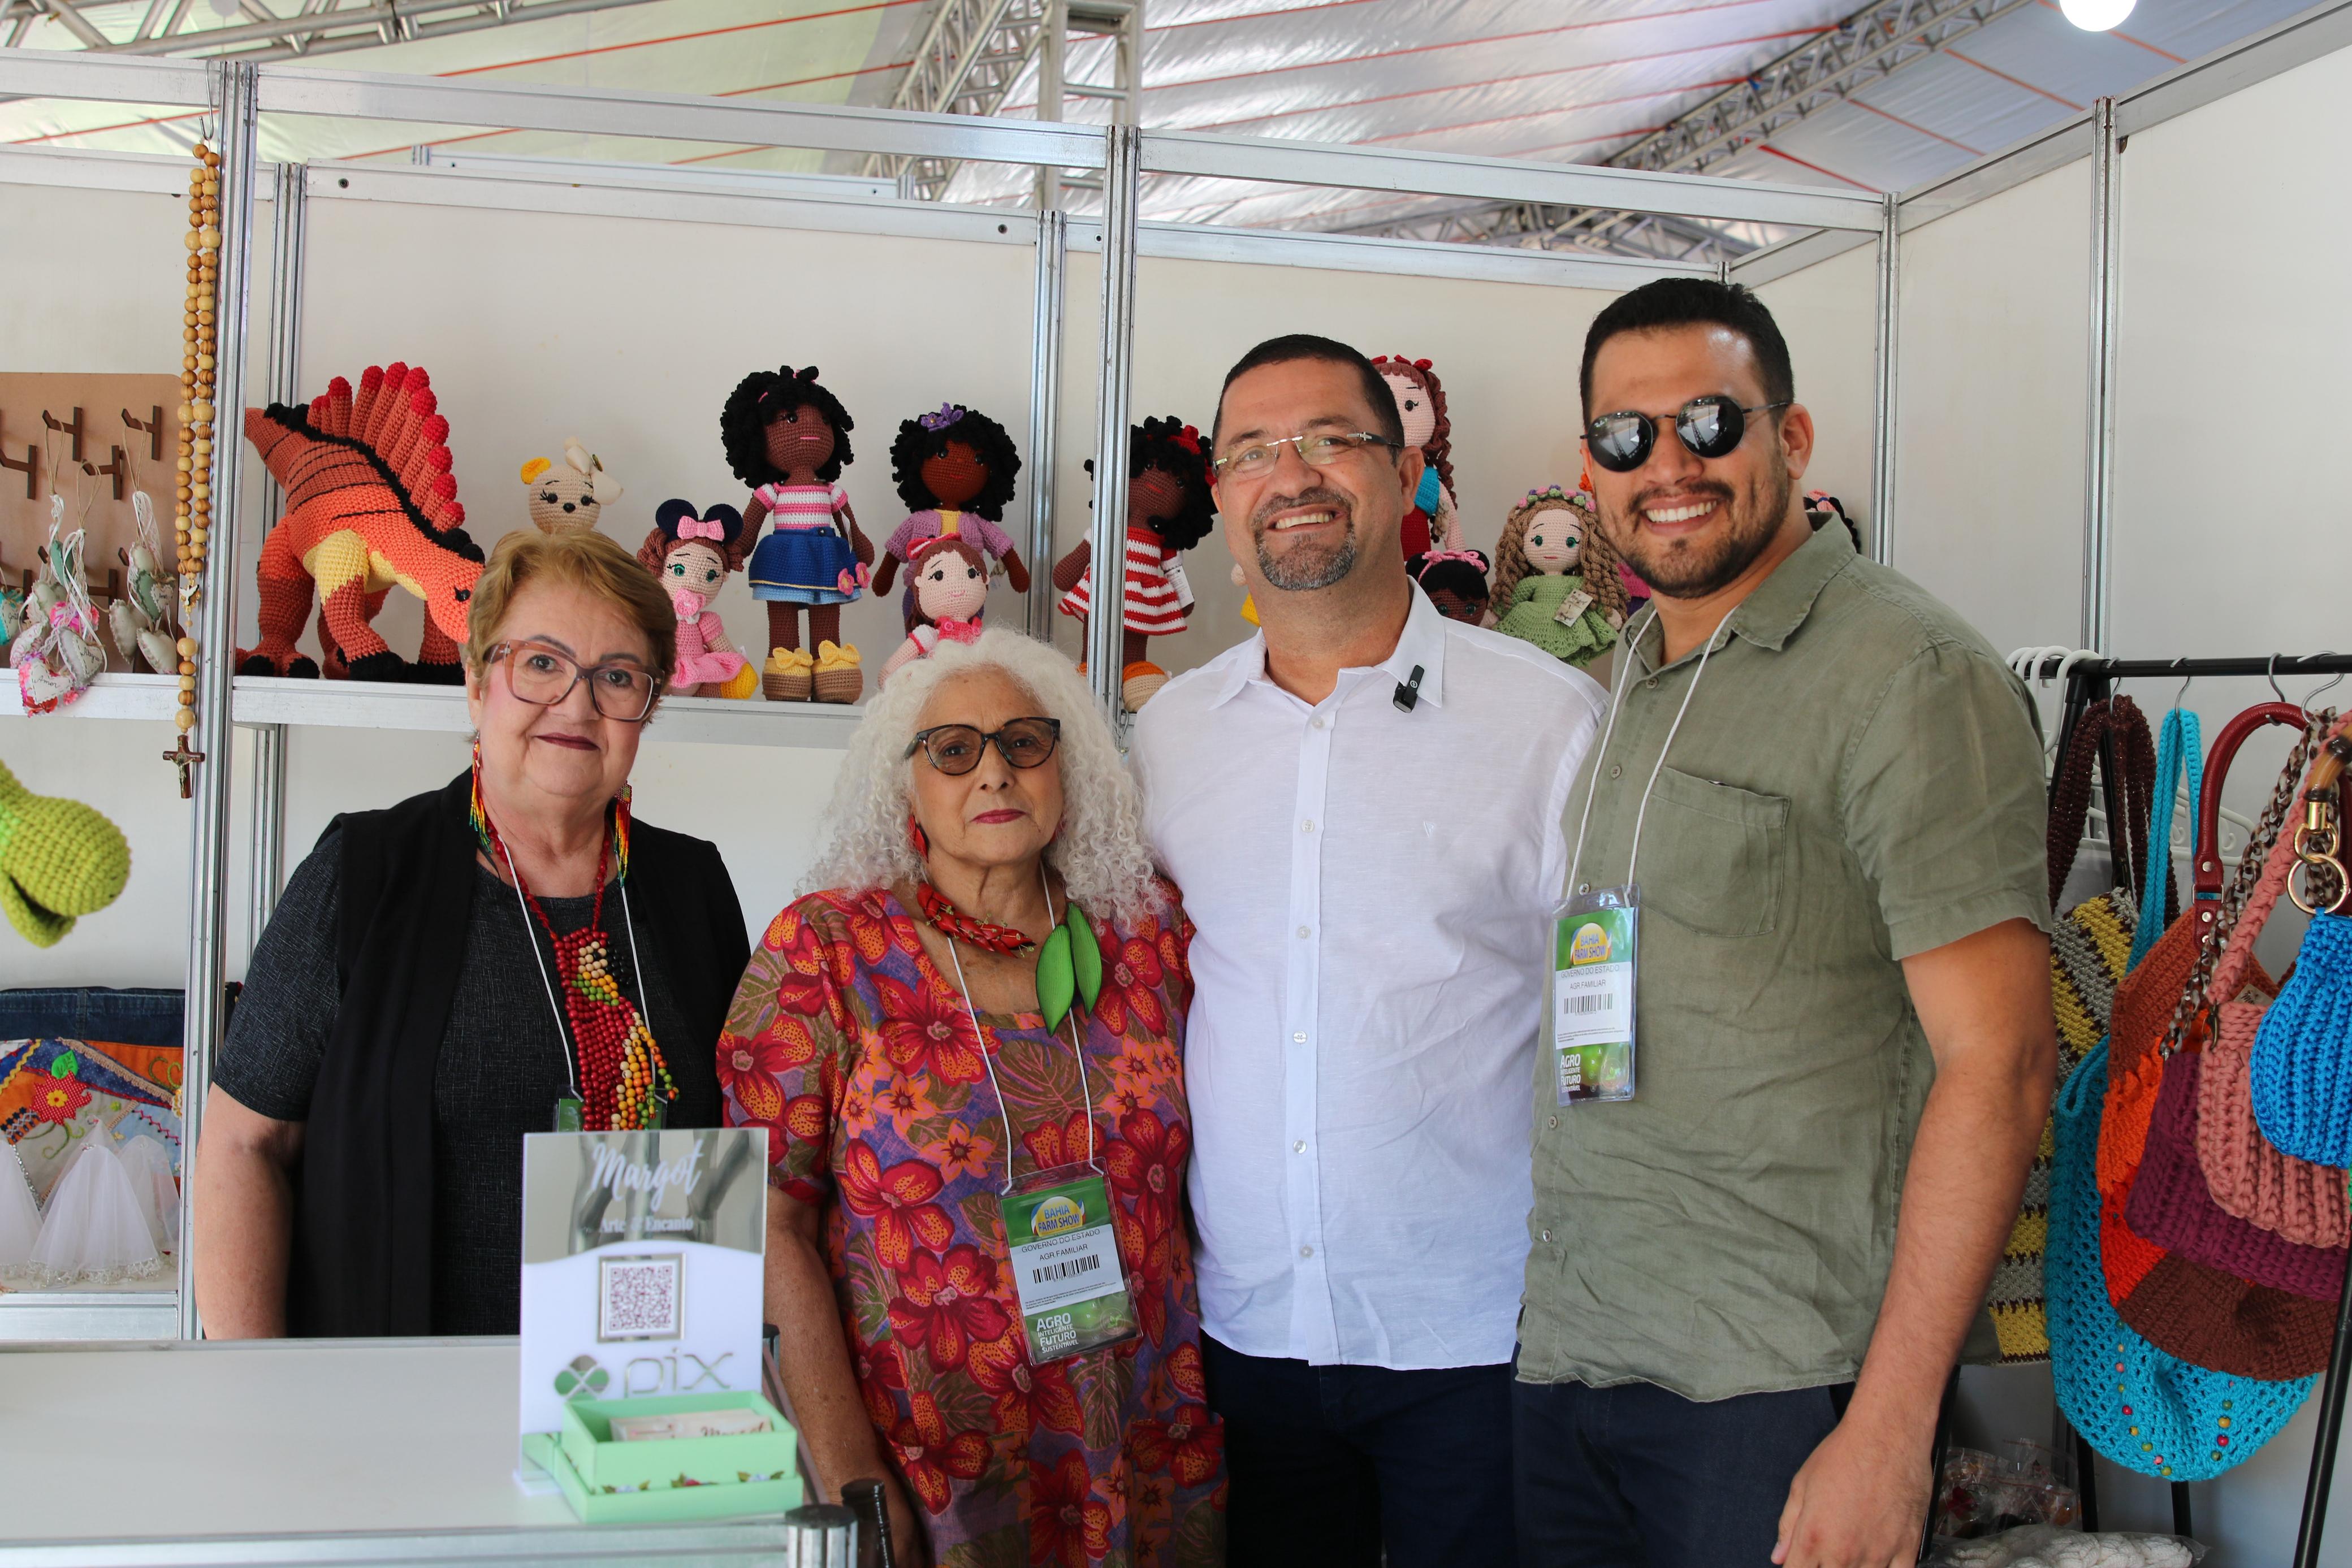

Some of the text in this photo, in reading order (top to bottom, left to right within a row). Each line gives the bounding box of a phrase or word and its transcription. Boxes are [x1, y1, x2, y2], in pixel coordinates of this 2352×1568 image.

[34, 675, 60, 688] Amor
[1580, 933, 1599, 946] BAHIA
[1575, 945, 1606, 960] FARM SHOW
[1561, 964, 1620, 978] GOVERNO DO ESTADO
[1560, 1054, 1581, 1068] AGRO
[1560, 1074, 1581, 1086] FUTURO
[591, 1139, 704, 1213] Margot
[1044, 1204, 1070, 1219] BAHIA
[600, 1218, 626, 1233] Arte
[645, 1215, 694, 1232] Encanto
[1038, 1219, 1058, 1233] FARM
[1060, 1214, 1080, 1228] SHOW
[1022, 1239, 1058, 1253] GOVERNO
[1072, 1228, 1100, 1241] ESTADO
[1037, 1313, 1071, 1332] AGRO
[1037, 1323, 1074, 1338] INTELIGENTE
[1040, 1330, 1076, 1347] FUTURO
[1042, 1339, 1079, 1354] SUSTENTÁVEL
[624, 1348, 734, 1398] pix
